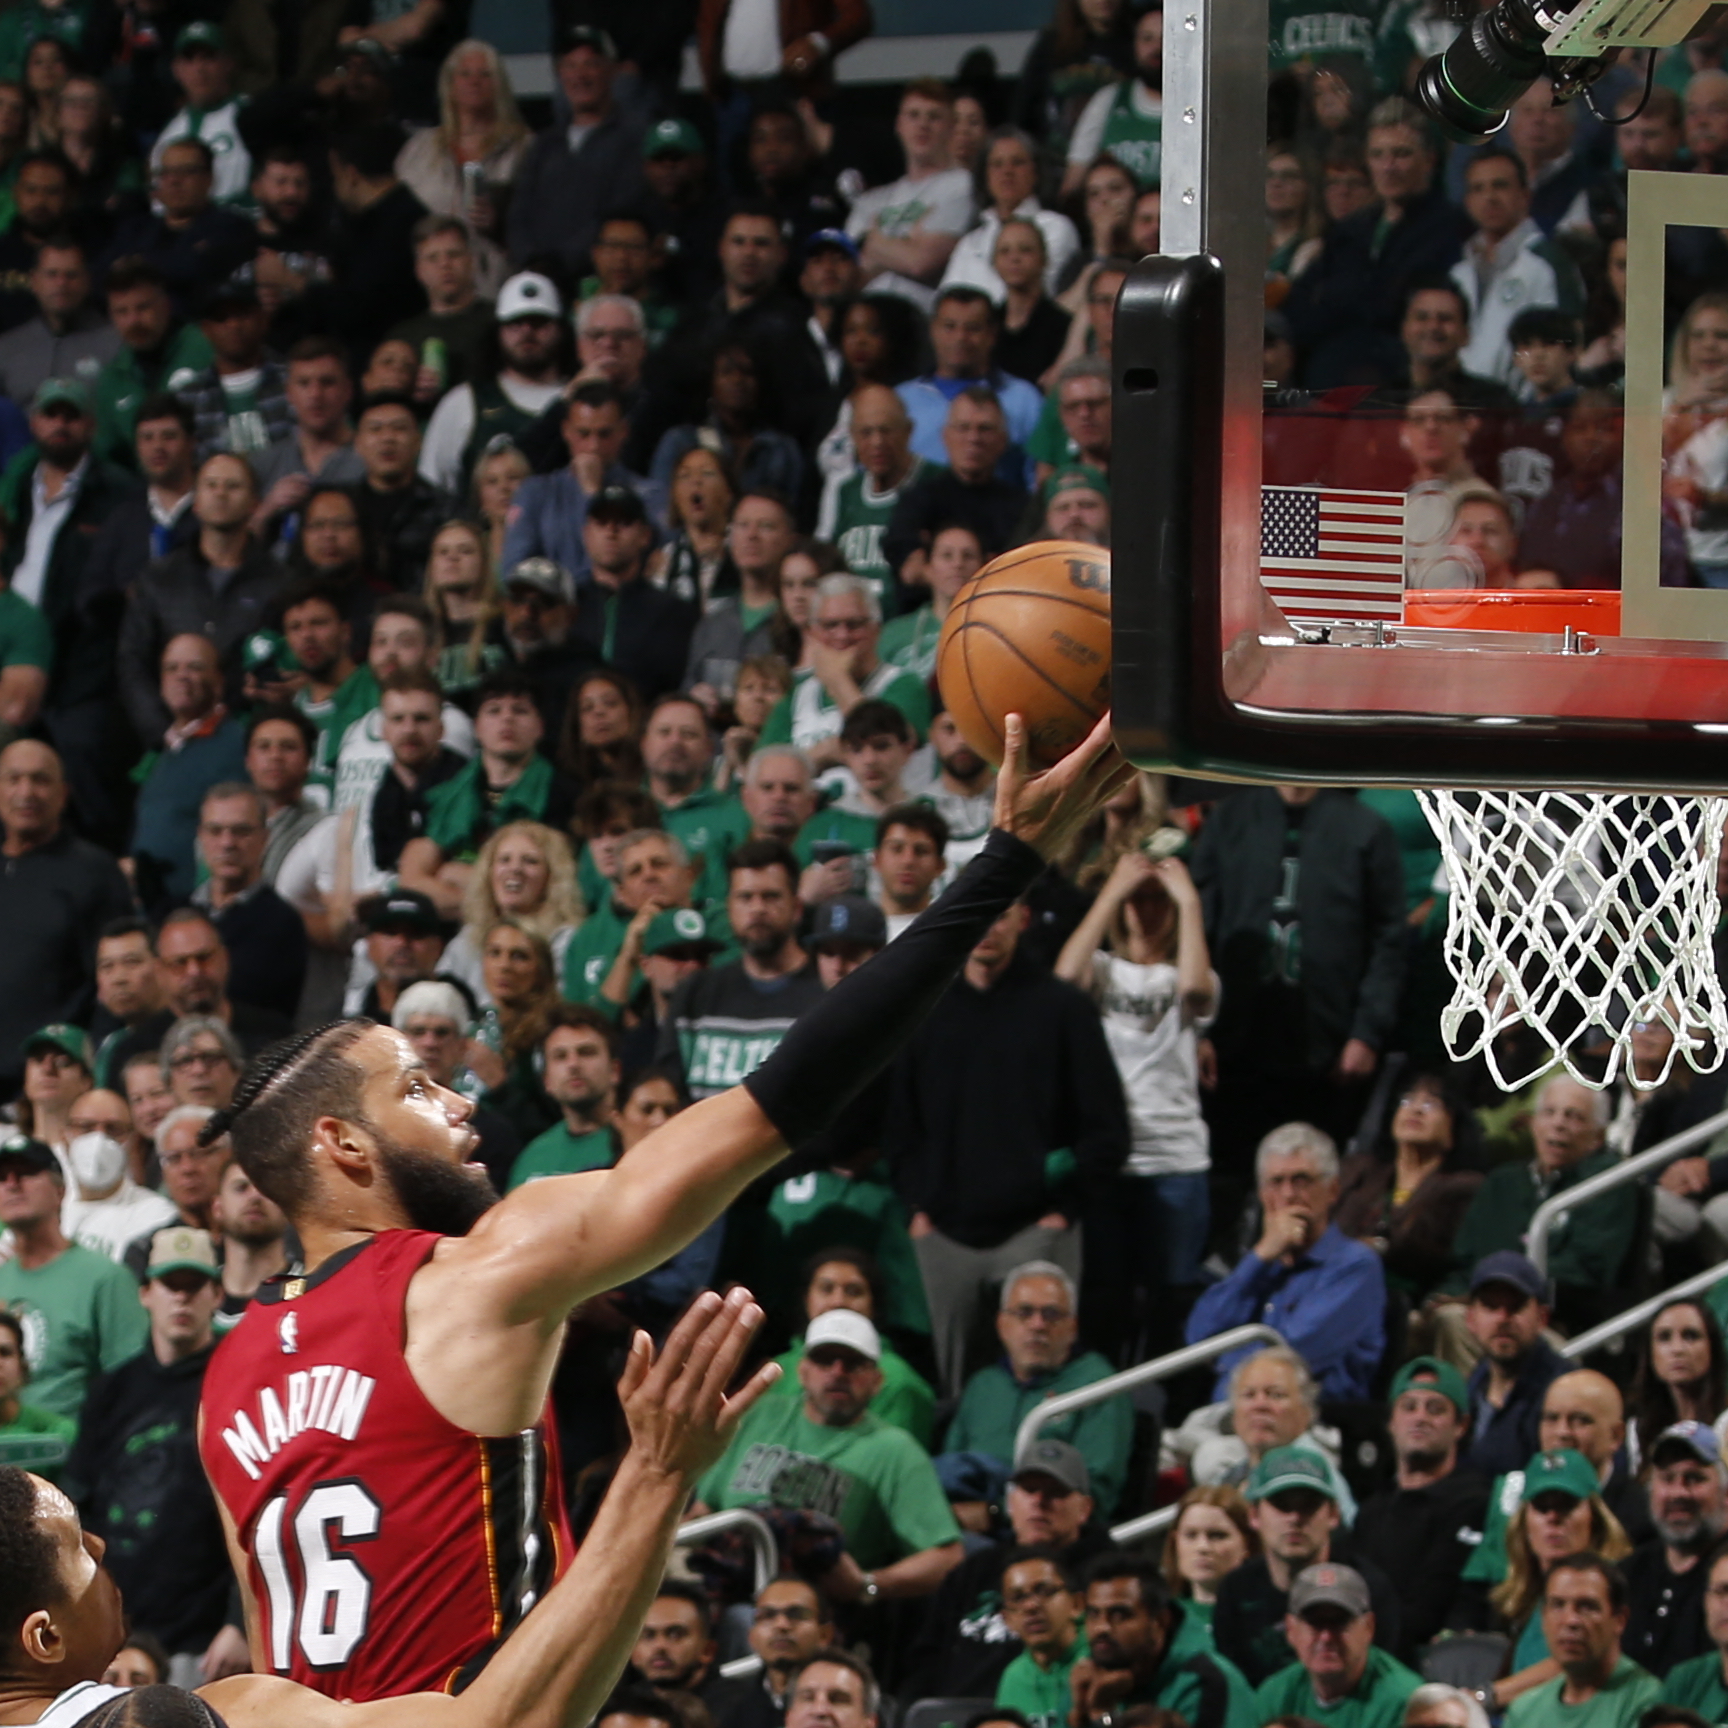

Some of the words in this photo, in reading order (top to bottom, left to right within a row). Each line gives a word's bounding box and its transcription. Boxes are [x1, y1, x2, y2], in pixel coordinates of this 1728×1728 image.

[222, 1364, 377, 1482] MARTIN
[729, 1442, 857, 1518] BOSTON
[252, 1474, 380, 1673] 16
